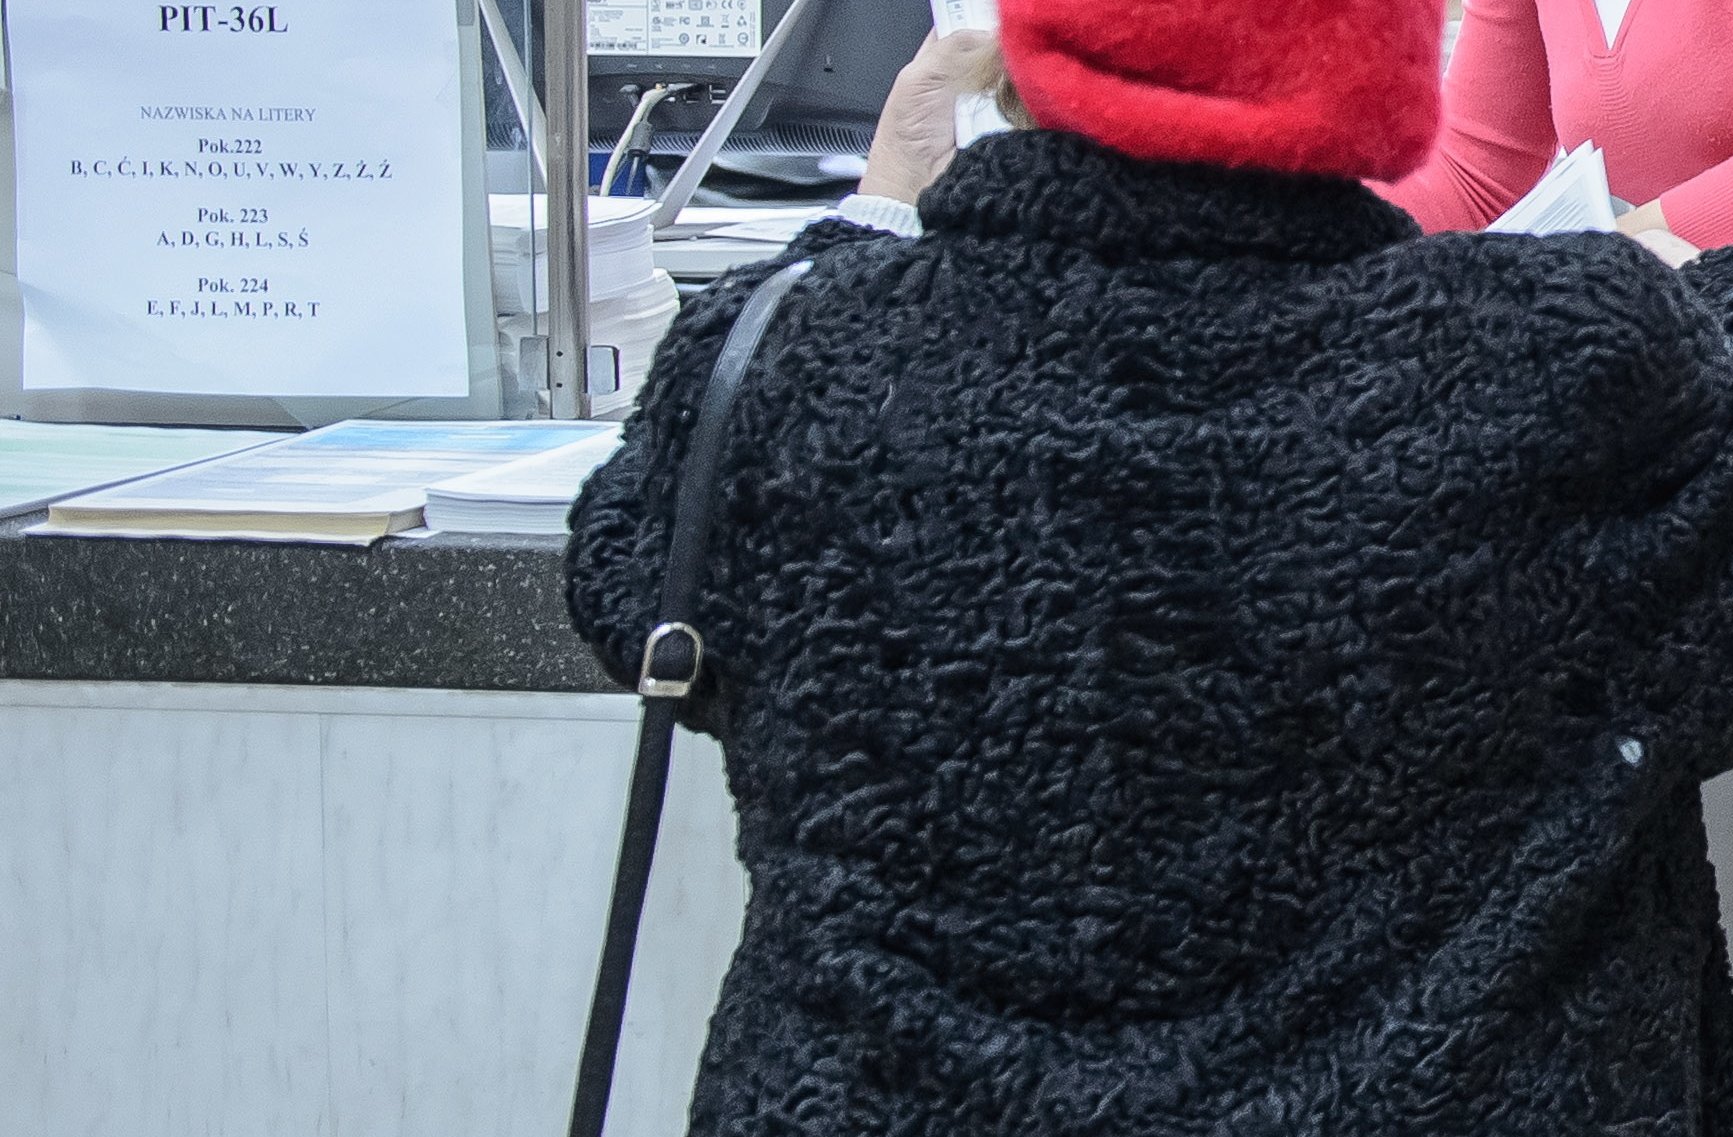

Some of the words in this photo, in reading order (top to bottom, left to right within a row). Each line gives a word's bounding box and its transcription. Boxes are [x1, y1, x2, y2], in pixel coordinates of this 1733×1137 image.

[158, 4, 289, 34] PIT-36L
[140, 105, 228, 122] NAZWISKA
[230, 106, 255, 122] NA
[258, 106, 317, 123] LITERY
[198, 138, 263, 154] Pok.222
[71, 160, 88, 178] B,
[93, 160, 112, 177] C,
[117, 155, 136, 178] Ć,
[142, 161, 154, 178] I,
[160, 161, 179, 178] K,
[185, 161, 203, 178] N,
[208, 161, 228, 179] O,
[233, 162, 251, 179] U,
[256, 162, 275, 180] V,
[279, 162, 304, 180] W,
[308, 163, 328, 180] Y,
[333, 163, 351, 181] Z,
[198, 208, 234, 223] Pok.
[240, 208, 269, 224] 223
[157, 230, 176, 247] A,
[181, 231, 200, 248] D,
[205, 231, 225, 248] G,
[230, 231, 250, 249] H,
[255, 231, 273, 249] L,
[277, 231, 293, 249] S,
[298, 227, 309, 248] Ś
[198, 277, 234, 293] Pok.
[240, 277, 269, 294] 224
[147, 300, 164, 316] E,
[169, 301, 186, 317] F,
[190, 301, 205, 318] J,
[211, 301, 228, 318] L,
[234, 301, 257, 318] M,
[262, 301, 279, 319] P,
[284, 302, 303, 319] R,
[307, 302, 320, 318] T
